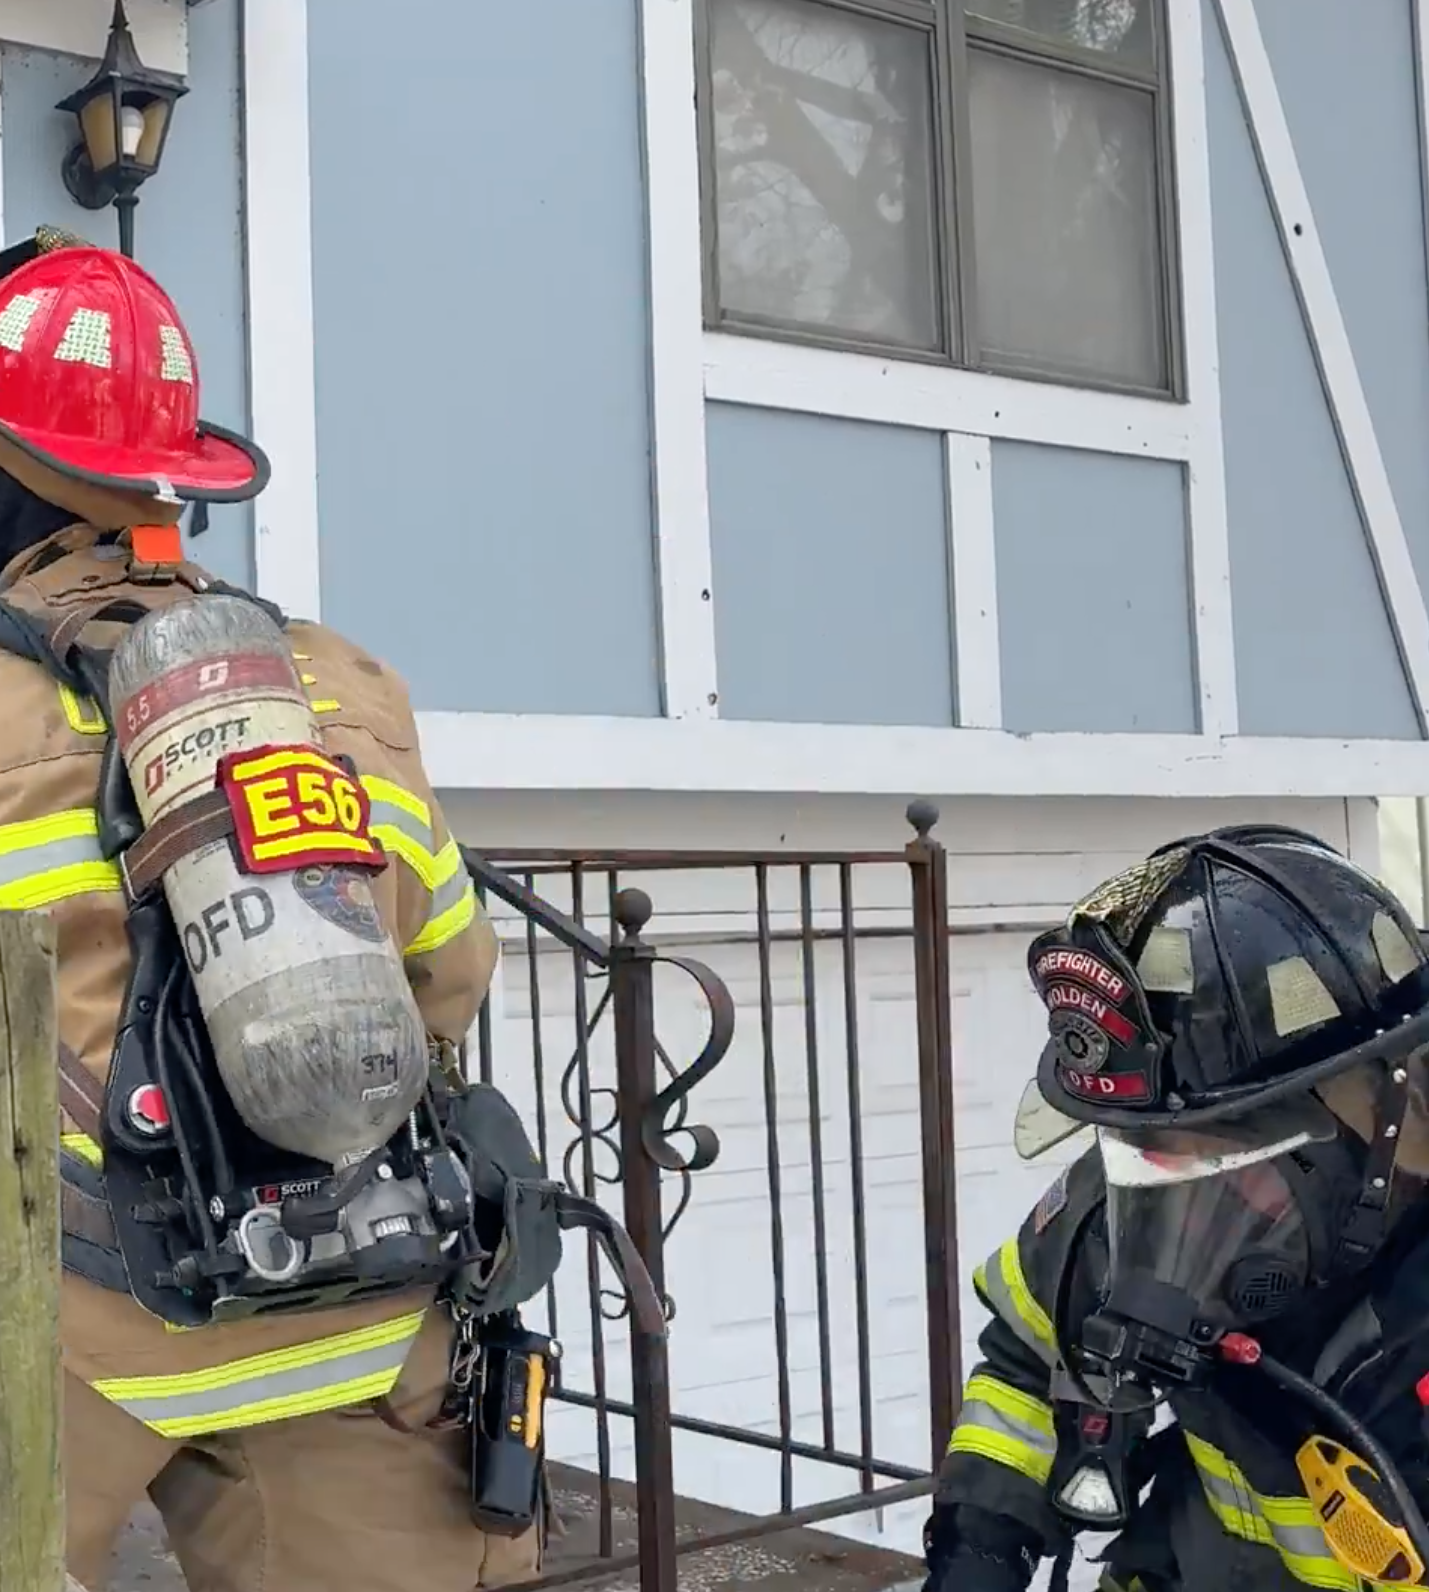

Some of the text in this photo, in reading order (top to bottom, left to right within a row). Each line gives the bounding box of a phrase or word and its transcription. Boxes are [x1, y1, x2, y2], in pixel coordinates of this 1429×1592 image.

[165, 716, 251, 767] SCOTT
[243, 771, 361, 837] E56
[182, 885, 275, 975] OFD
[1035, 951, 1124, 996] REFIGHTER
[1069, 1069, 1116, 1094] OFD
[280, 1180, 322, 1196] SCOTT
